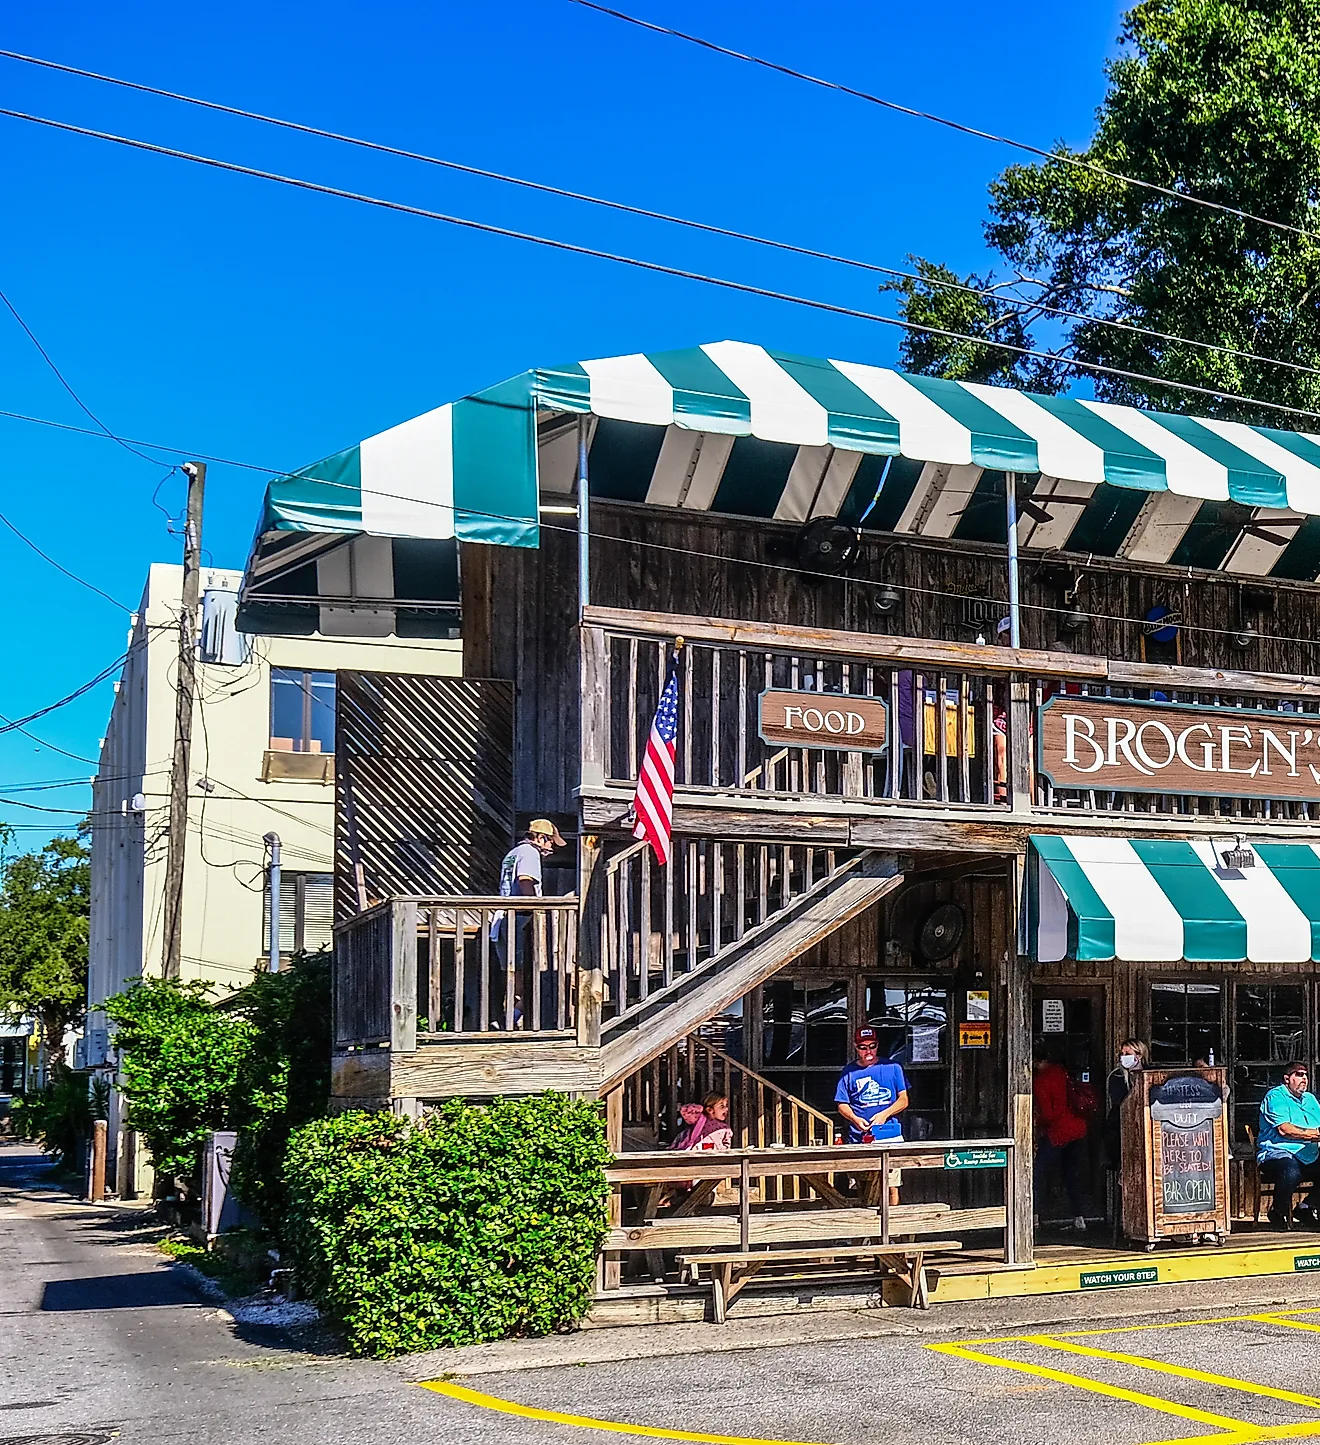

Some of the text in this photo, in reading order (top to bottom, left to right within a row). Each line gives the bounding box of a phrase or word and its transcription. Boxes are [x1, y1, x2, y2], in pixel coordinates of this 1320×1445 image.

[783, 706, 865, 735] FOOD
[1174, 1113, 1198, 1123] DUTY
[1162, 1131, 1209, 1147] PLEASE WAIT
[1164, 1150, 1202, 1163] HERE TO
[1164, 1165, 1173, 1175] BE
[1164, 1179, 1211, 1202] BAR OPEN
[1084, 1271, 1156, 1284] WATCH YOUR STEP
